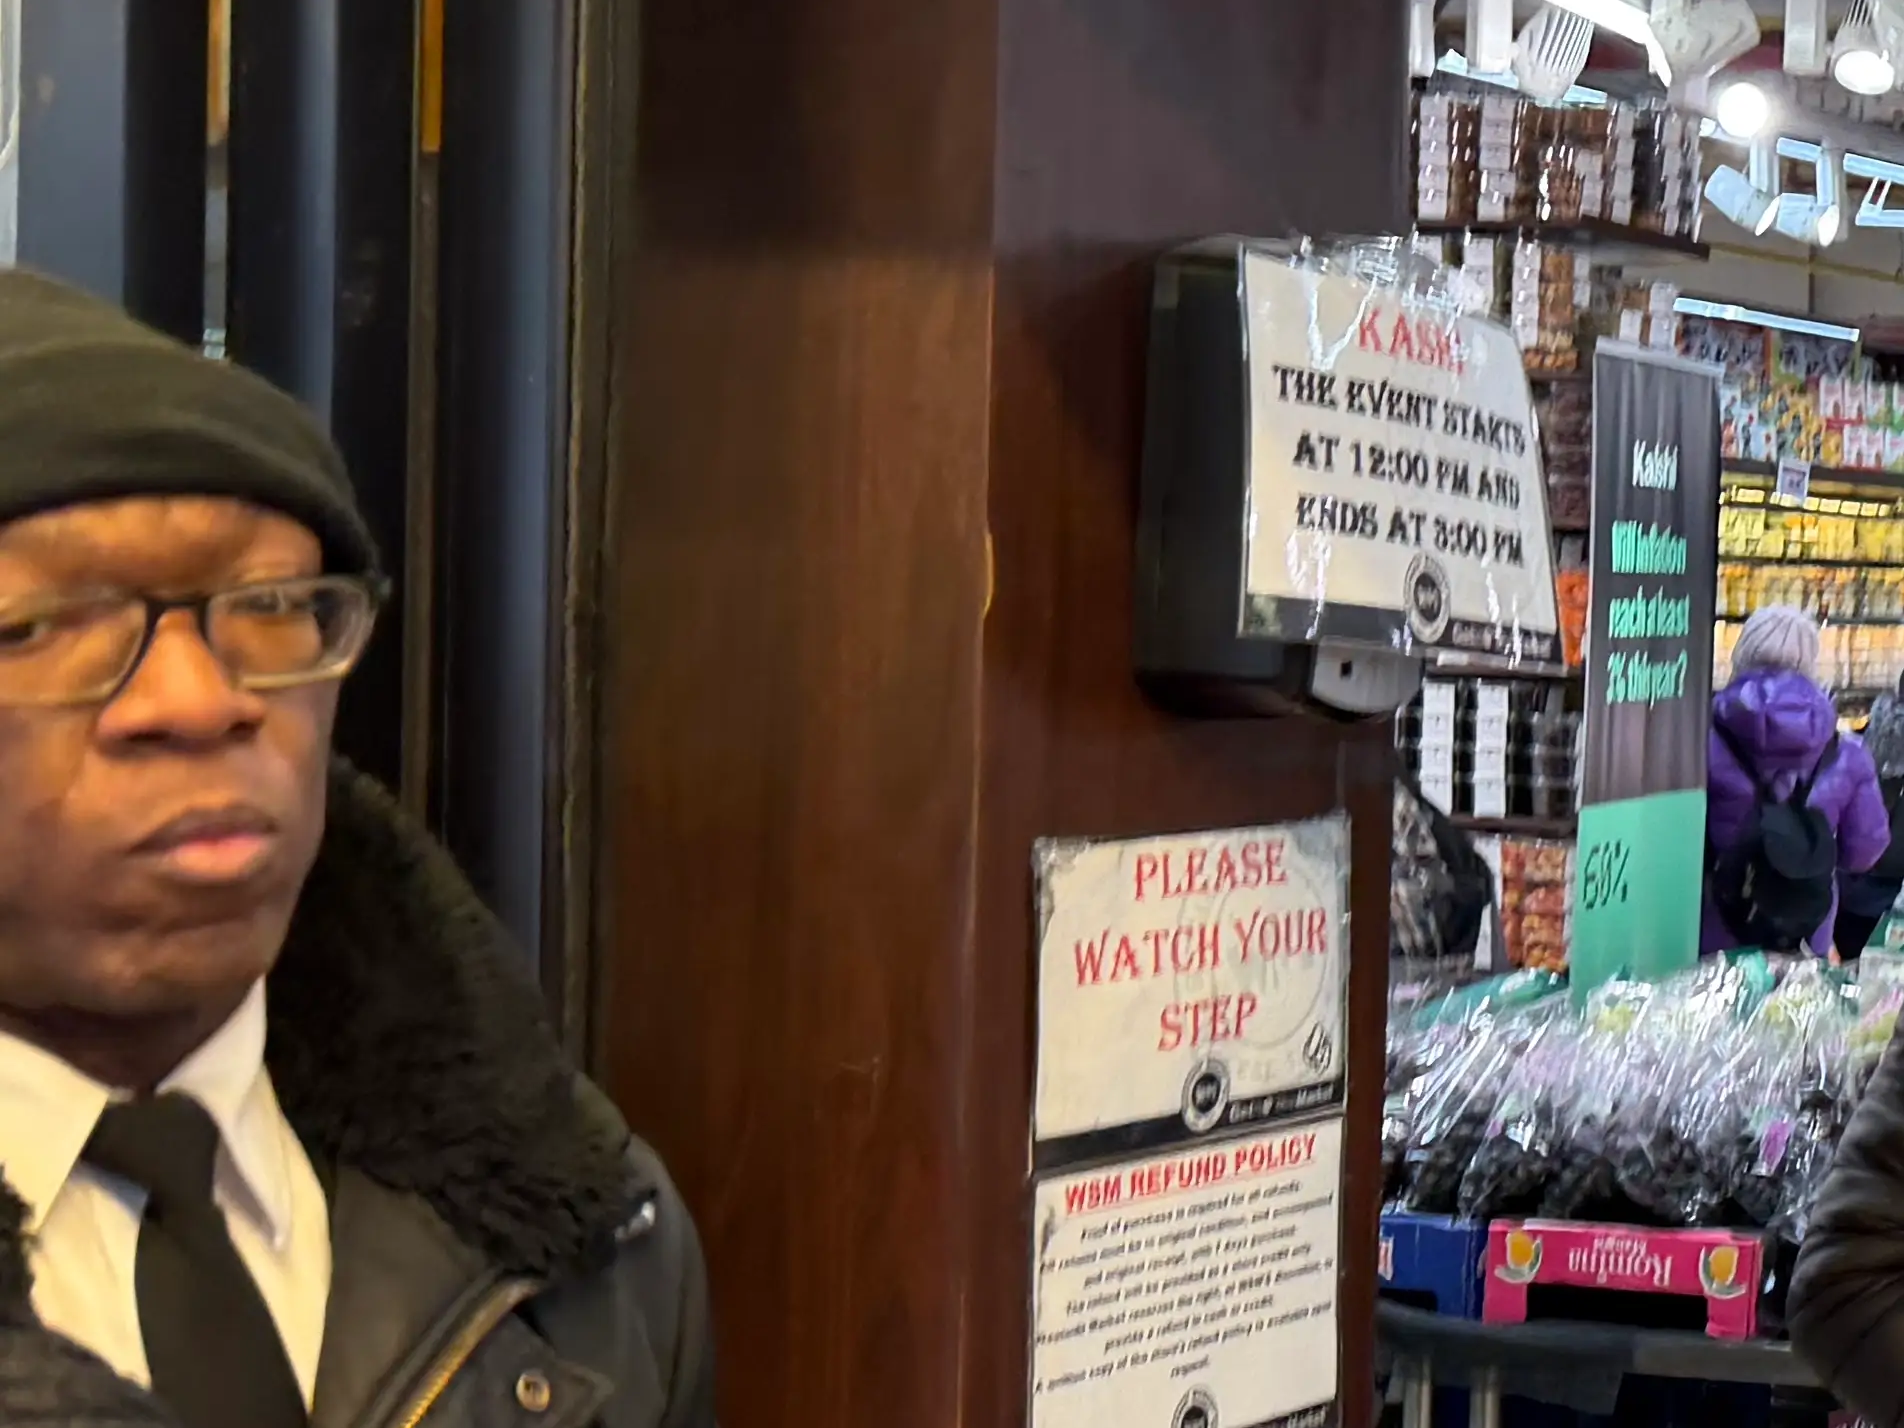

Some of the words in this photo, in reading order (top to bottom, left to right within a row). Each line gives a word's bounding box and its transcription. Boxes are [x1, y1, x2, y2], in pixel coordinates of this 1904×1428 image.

[1271, 365, 1337, 410] THE
[1346, 378, 1438, 427] EVENT
[1442, 397, 1527, 458] STARTS
[1292, 430, 1339, 470] AT
[1350, 440, 1429, 492] 12:00
[1436, 460, 1470, 497] PM
[1477, 465, 1521, 510] AND
[1632, 439, 1678, 491] Kalshi
[1295, 495, 1379, 538] ENDS
[1386, 506, 1427, 547] AT
[1493, 526, 1524, 569] PM
[1135, 838, 1288, 902] PLEASE
[1073, 923, 1222, 988] WATCH
[1234, 907, 1328, 961] YOUR
[1158, 993, 1259, 1052] STEP
[1130, 1151, 1227, 1200] REFUND
[1234, 1133, 1318, 1171] POLICY
